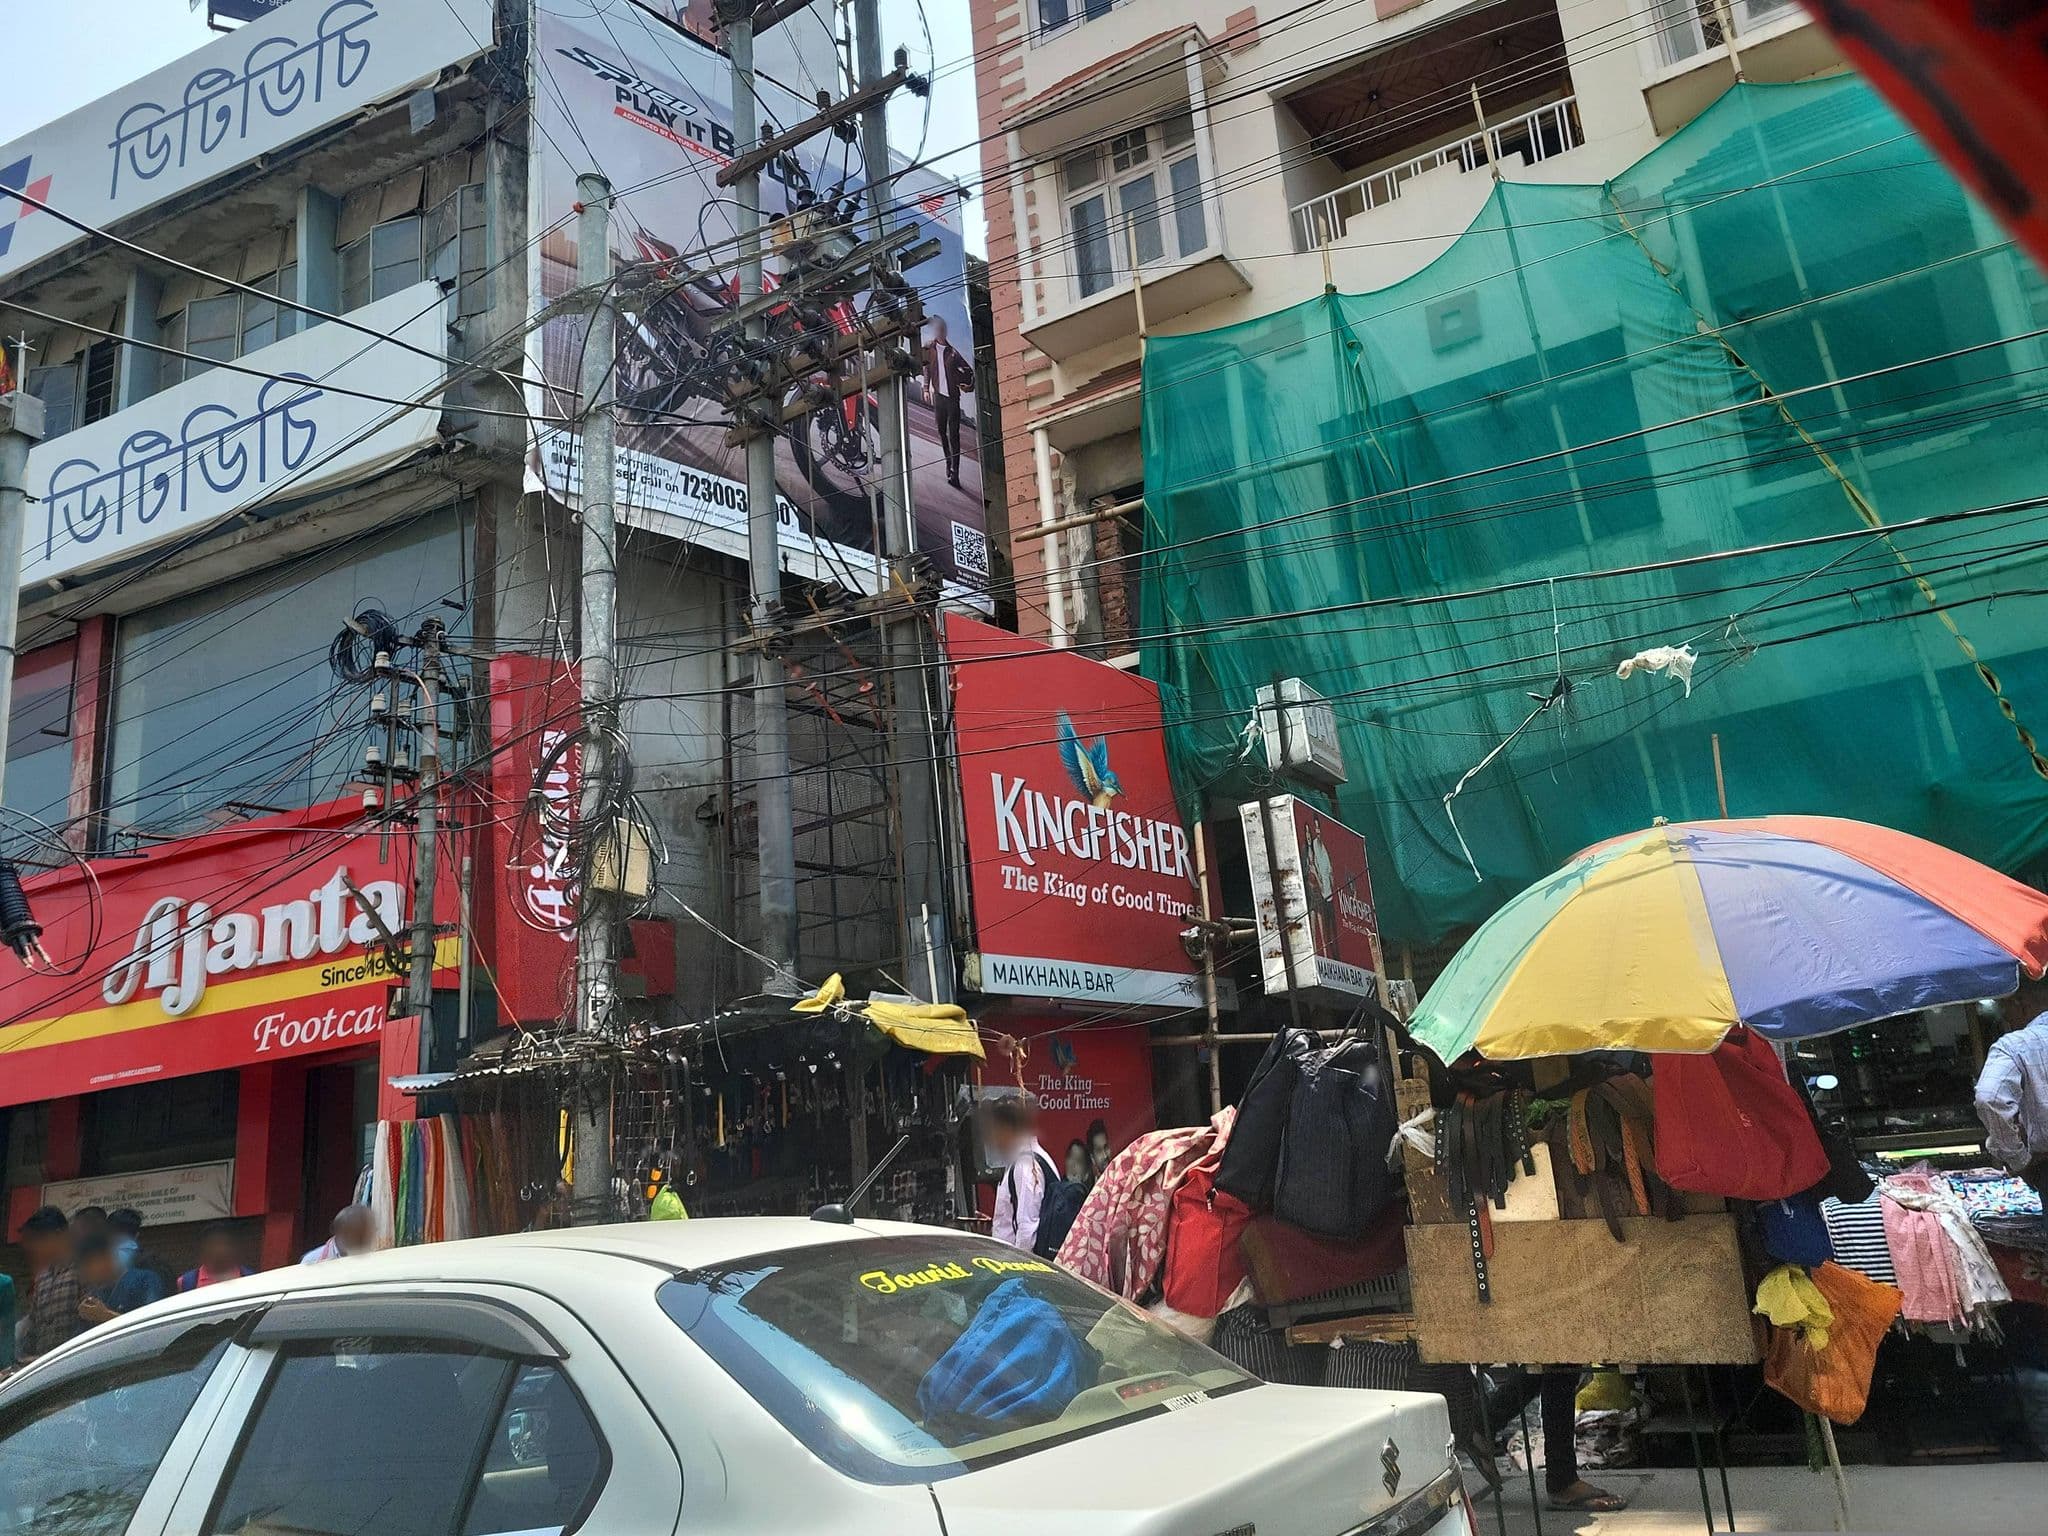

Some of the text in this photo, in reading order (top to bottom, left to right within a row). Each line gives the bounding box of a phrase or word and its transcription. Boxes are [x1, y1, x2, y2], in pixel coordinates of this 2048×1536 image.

[616, 85, 677, 128] PLAY
[686, 119, 706, 143] IT
[640, 475, 662, 488] call
[665, 481, 679, 494] on
[991, 772, 1200, 888] KINGFISHER
[1001, 865, 1203, 919] The King of Good Times
[103, 866, 413, 1015] Ajanta
[321, 967, 364, 987] Since
[993, 962, 1115, 993] MAIKHANA BAR
[1039, 1075, 1092, 1094] The King
[1039, 1094, 1110, 1110] Good Times
[860, 1262, 973, 1294] Tourist
